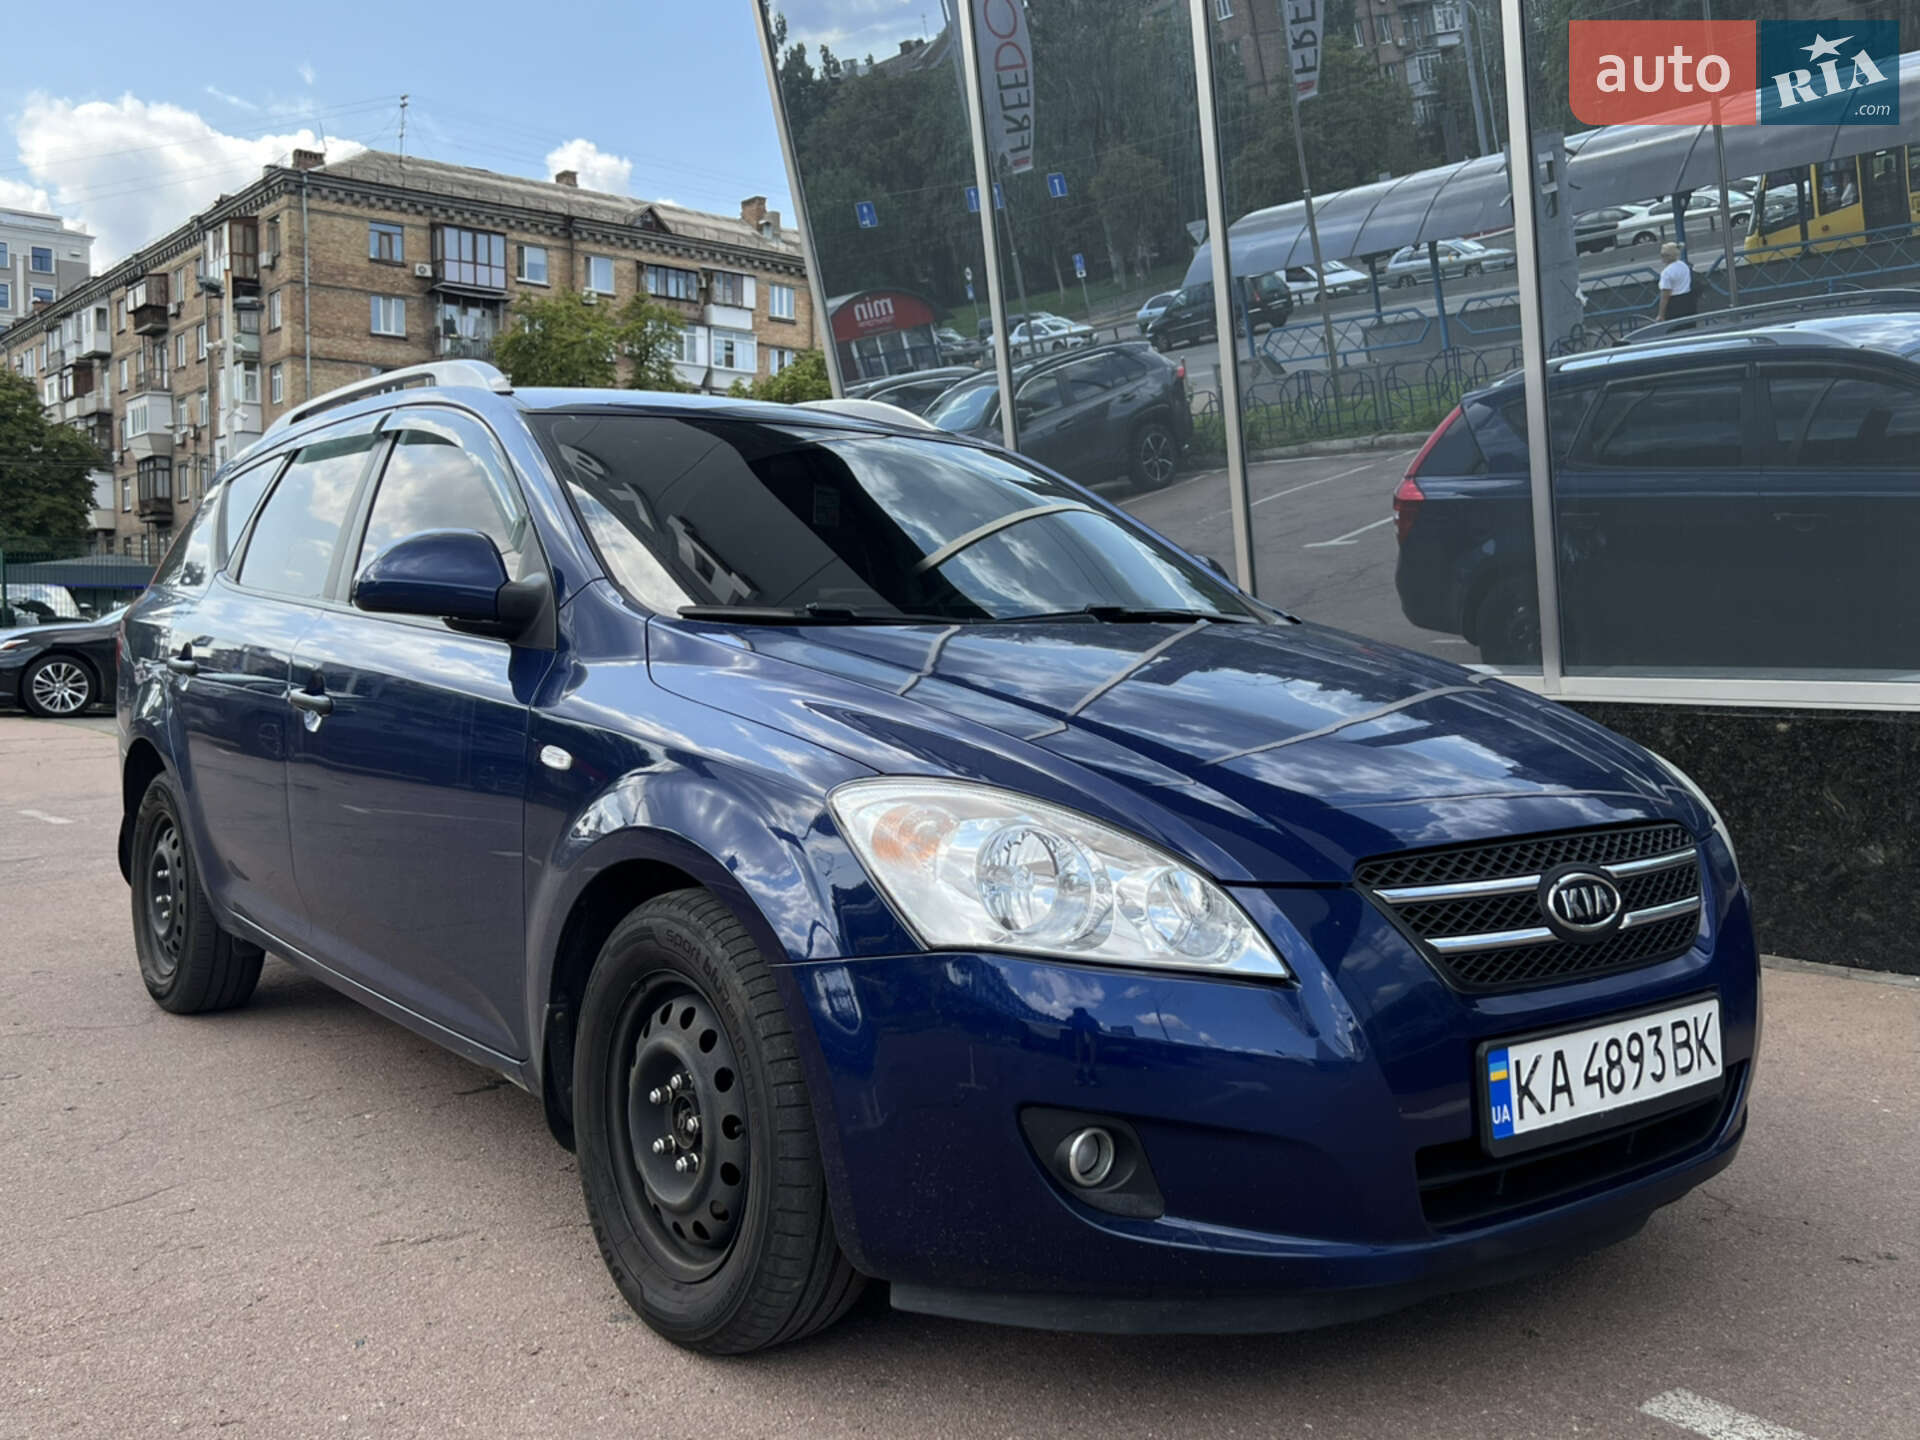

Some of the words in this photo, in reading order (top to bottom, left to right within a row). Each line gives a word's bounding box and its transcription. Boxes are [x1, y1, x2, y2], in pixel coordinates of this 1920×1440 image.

[1560, 886, 1611, 919] KIA
[664, 927, 702, 964] sport
[1514, 1050, 1575, 1120] KA
[1583, 1026, 1667, 1099] 4893
[1670, 1013, 1717, 1076] BK
[1491, 1103, 1511, 1125] UA
